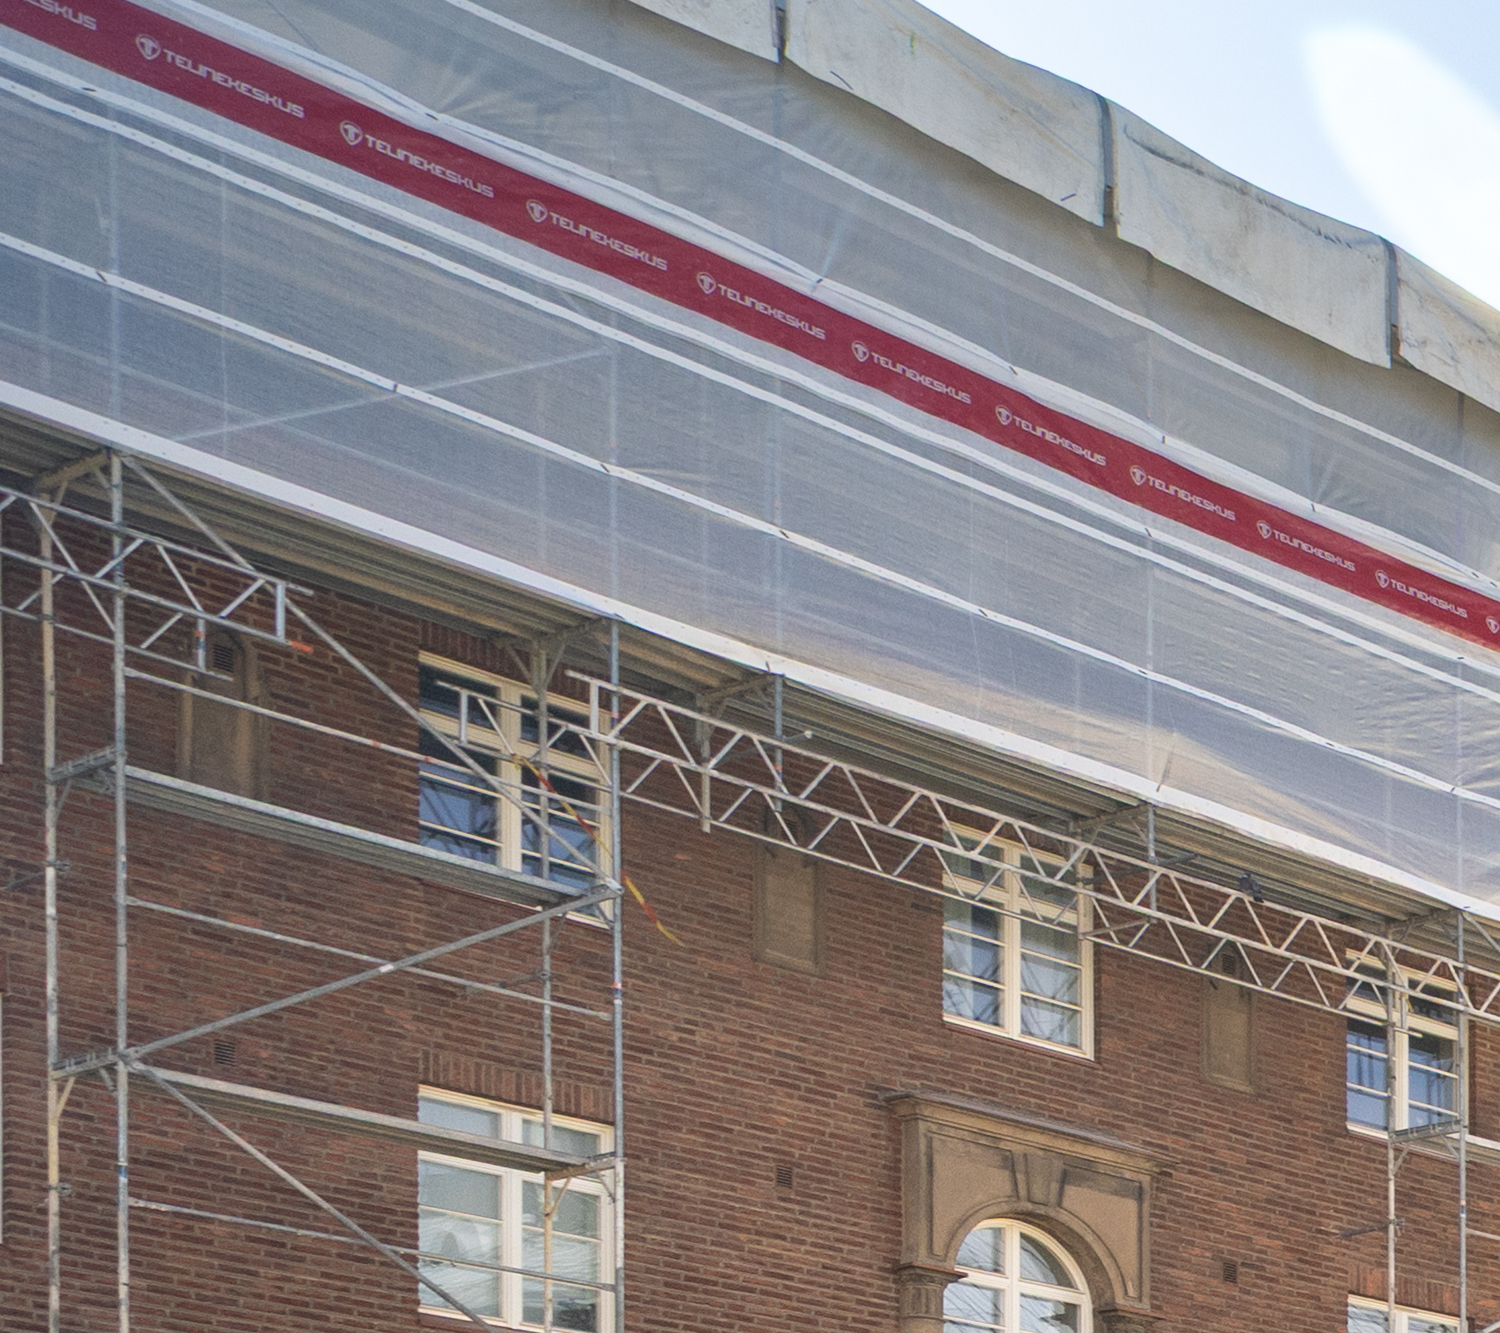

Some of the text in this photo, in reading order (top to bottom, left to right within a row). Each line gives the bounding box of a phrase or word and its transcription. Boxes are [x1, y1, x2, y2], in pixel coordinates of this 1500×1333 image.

[163, 48, 305, 119] TELINEKESKUS
[365, 134, 494, 198] TELINEKESKUS
[549, 211, 668, 271] TELINEKESKUS
[718, 284, 826, 341] TELINEKESKUS
[871, 352, 972, 405] TELINEKESKUS
[1013, 415, 1107, 466] TELINEKESKUS
[1147, 475, 1236, 521] TELINEKESKUS
[1272, 530, 1356, 572] TELINEKESKUS
[1390, 578, 1467, 618] TELINEKESKUS
